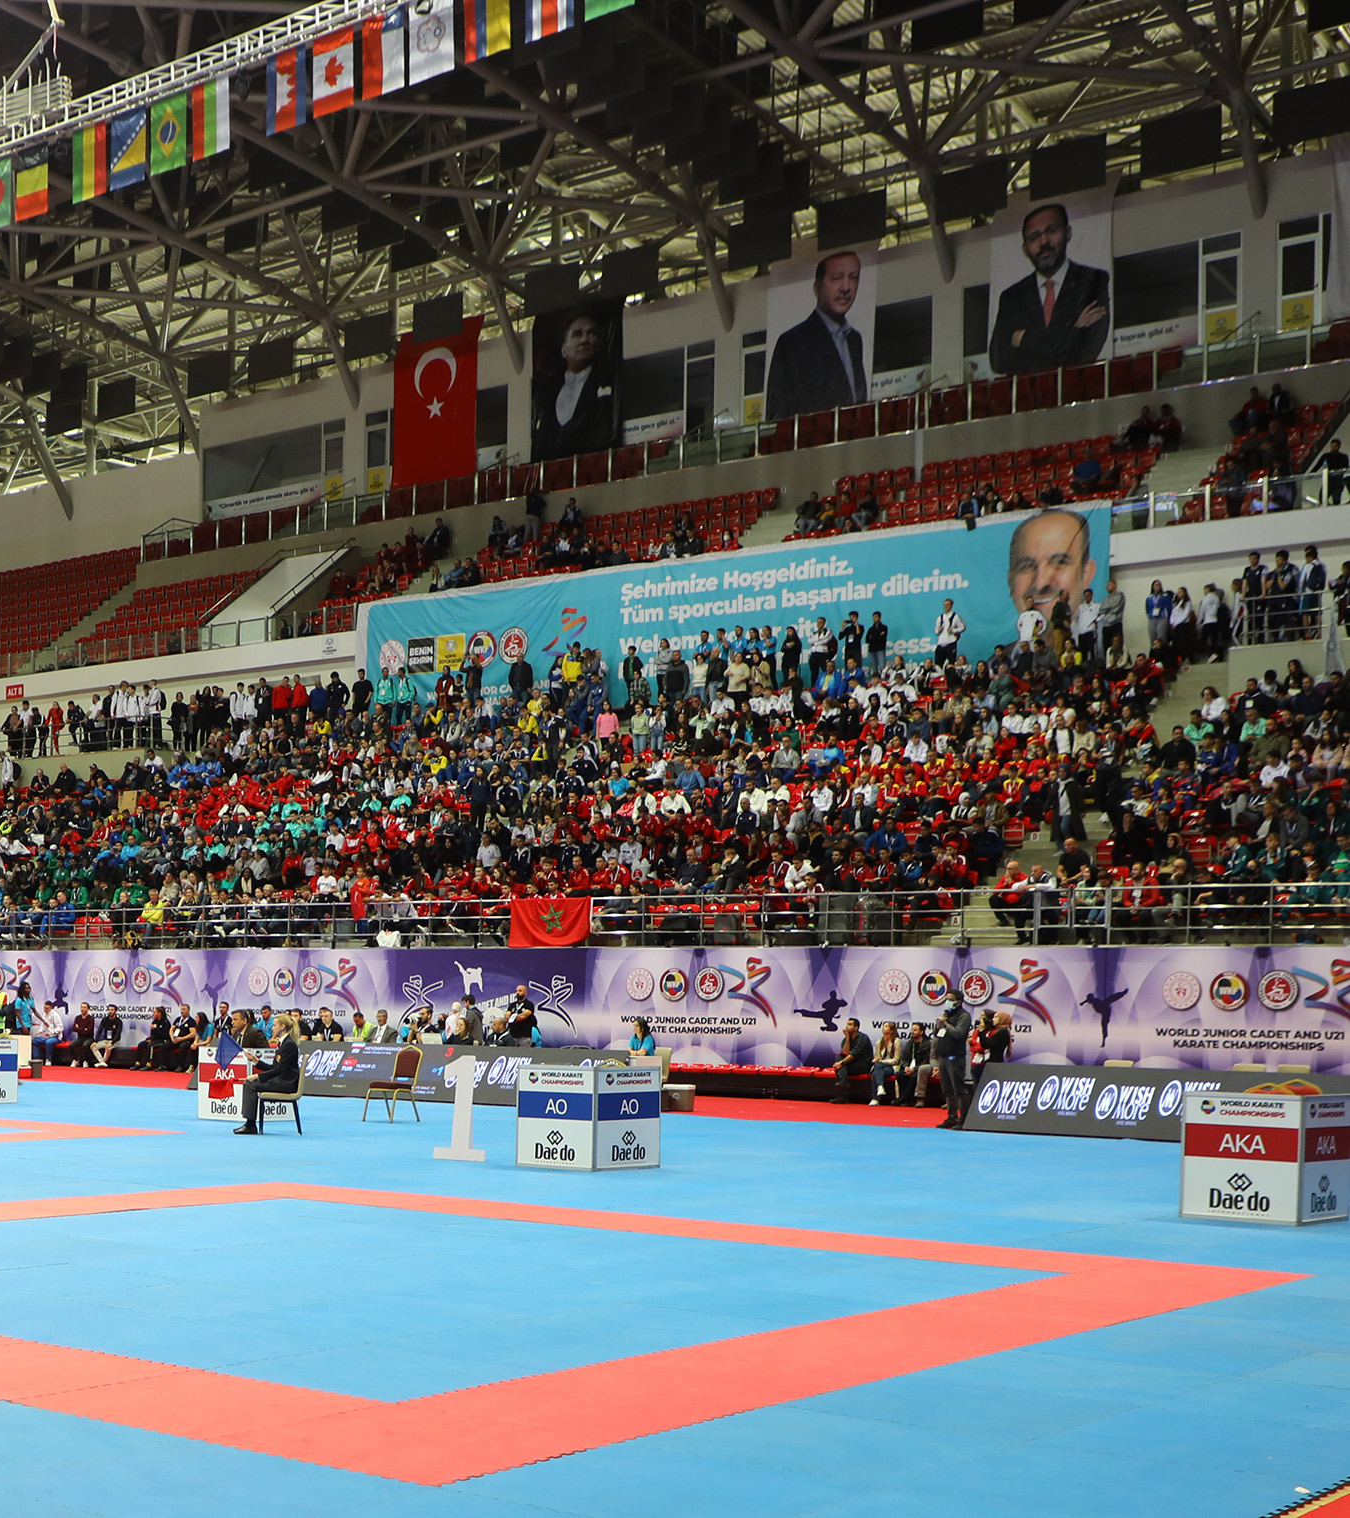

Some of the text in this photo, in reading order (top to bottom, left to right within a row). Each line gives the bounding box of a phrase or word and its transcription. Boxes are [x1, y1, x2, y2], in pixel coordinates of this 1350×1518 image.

[620, 555, 854, 604] Şehrimize Hoşgeldiniz.
[620, 569, 970, 625] Tüm sporculara başarılar dilerim.
[7, 686, 18, 697] ALT
[655, 1016, 686, 1024] JUNIOR
[688, 1017, 719, 1025] CADET
[720, 1017, 740, 1025] AND
[669, 1026, 742, 1034] CHAMPIONSHIPS
[1156, 1028, 1345, 1040] WORLD JUNIOR CADET AND U21
[1173, 1039, 1324, 1051] KARATE CHAMPIONSHIPS
[215, 1068, 235, 1080] AKA
[1000, 1081, 1036, 1101] WISH
[1059, 1077, 1096, 1096] WISH
[1118, 1086, 1156, 1105] WISH
[545, 1098, 568, 1115] AO
[620, 1098, 639, 1115] AO
[1220, 1100, 1284, 1109] WORLD KARATE
[1220, 1109, 1286, 1119] CHAMPIONSHIPS
[1218, 1133, 1266, 1155] AKA
[1316, 1136, 1336, 1155] AKA
